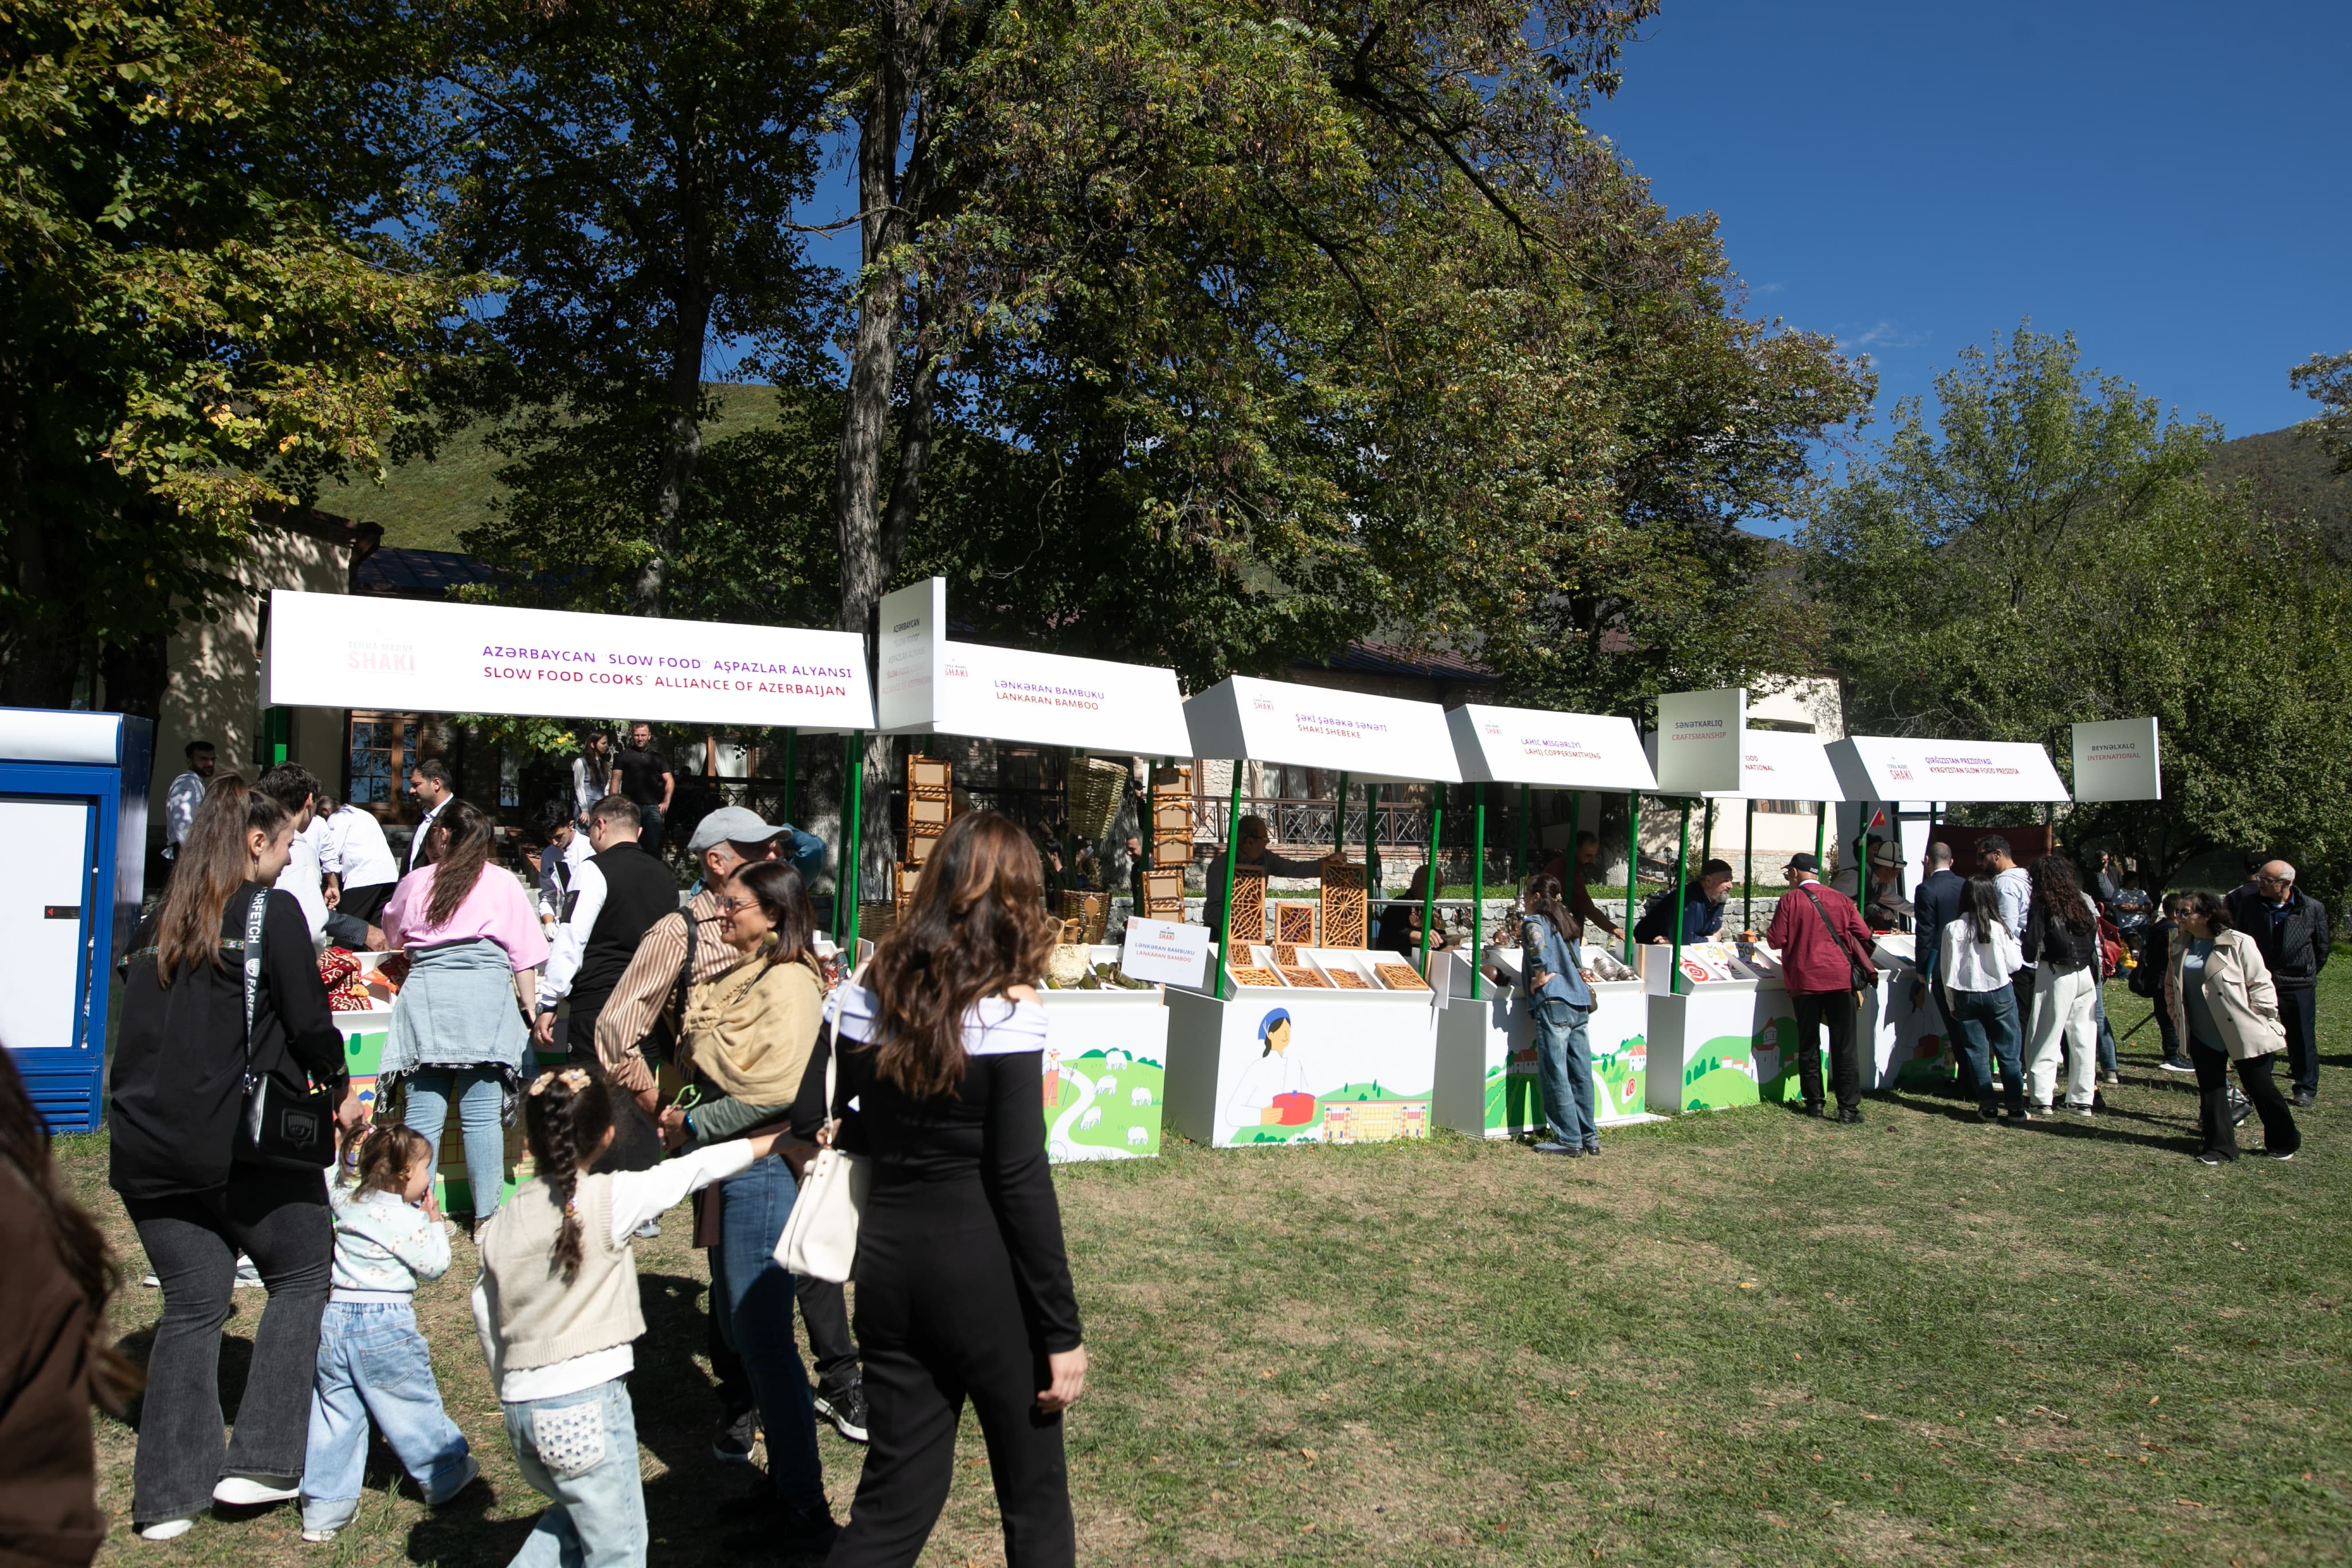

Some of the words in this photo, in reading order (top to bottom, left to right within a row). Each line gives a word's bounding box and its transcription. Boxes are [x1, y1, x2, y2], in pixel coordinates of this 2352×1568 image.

[348, 650, 414, 672] SHAKI
[483, 646, 595, 663] AZƏRBAYCAN
[714, 660, 787, 674] AŞPAZLAR
[792, 665, 852, 678] ALYANSI
[944, 668, 968, 677] SHAKI
[484, 667, 531, 680] SLOW
[538, 669, 583, 682] FOOD
[655, 676, 730, 691] ALLIANCE
[735, 681, 754, 691] OF
[758, 682, 845, 697] AZERBAIJAN
[994, 680, 1052, 693] LƏNKƏRAN
[1055, 687, 1104, 699] BAMBUKU
[996, 692, 1052, 705] LANKARAN
[1055, 698, 1099, 710] BAMBOO
[1253, 701, 1274, 711] SHAKI
[1318, 716, 1353, 727] ŞƏBƏKƏ
[1675, 720, 1723, 728] SƏNƏTKARLIQ
[1297, 724, 1324, 734] SHAKI
[1326, 727, 1362, 739] SHEBEKE
[1672, 731, 1727, 740] CRAFTSMANSHIP
[1524, 748, 1543, 756] LAHIJ
[1544, 749, 1601, 759] COPPERSMITHING
[2087, 752, 2141, 761] INTERNATIONAL
[1890, 770, 1914, 780] SHAKI
[1135, 942, 1166, 951] LƏNKƏRAN
[1167, 946, 1195, 955] BAMBUKU
[1136, 950, 1166, 959] LANKARAN
[1167, 954, 1191, 963] BAMBOO
